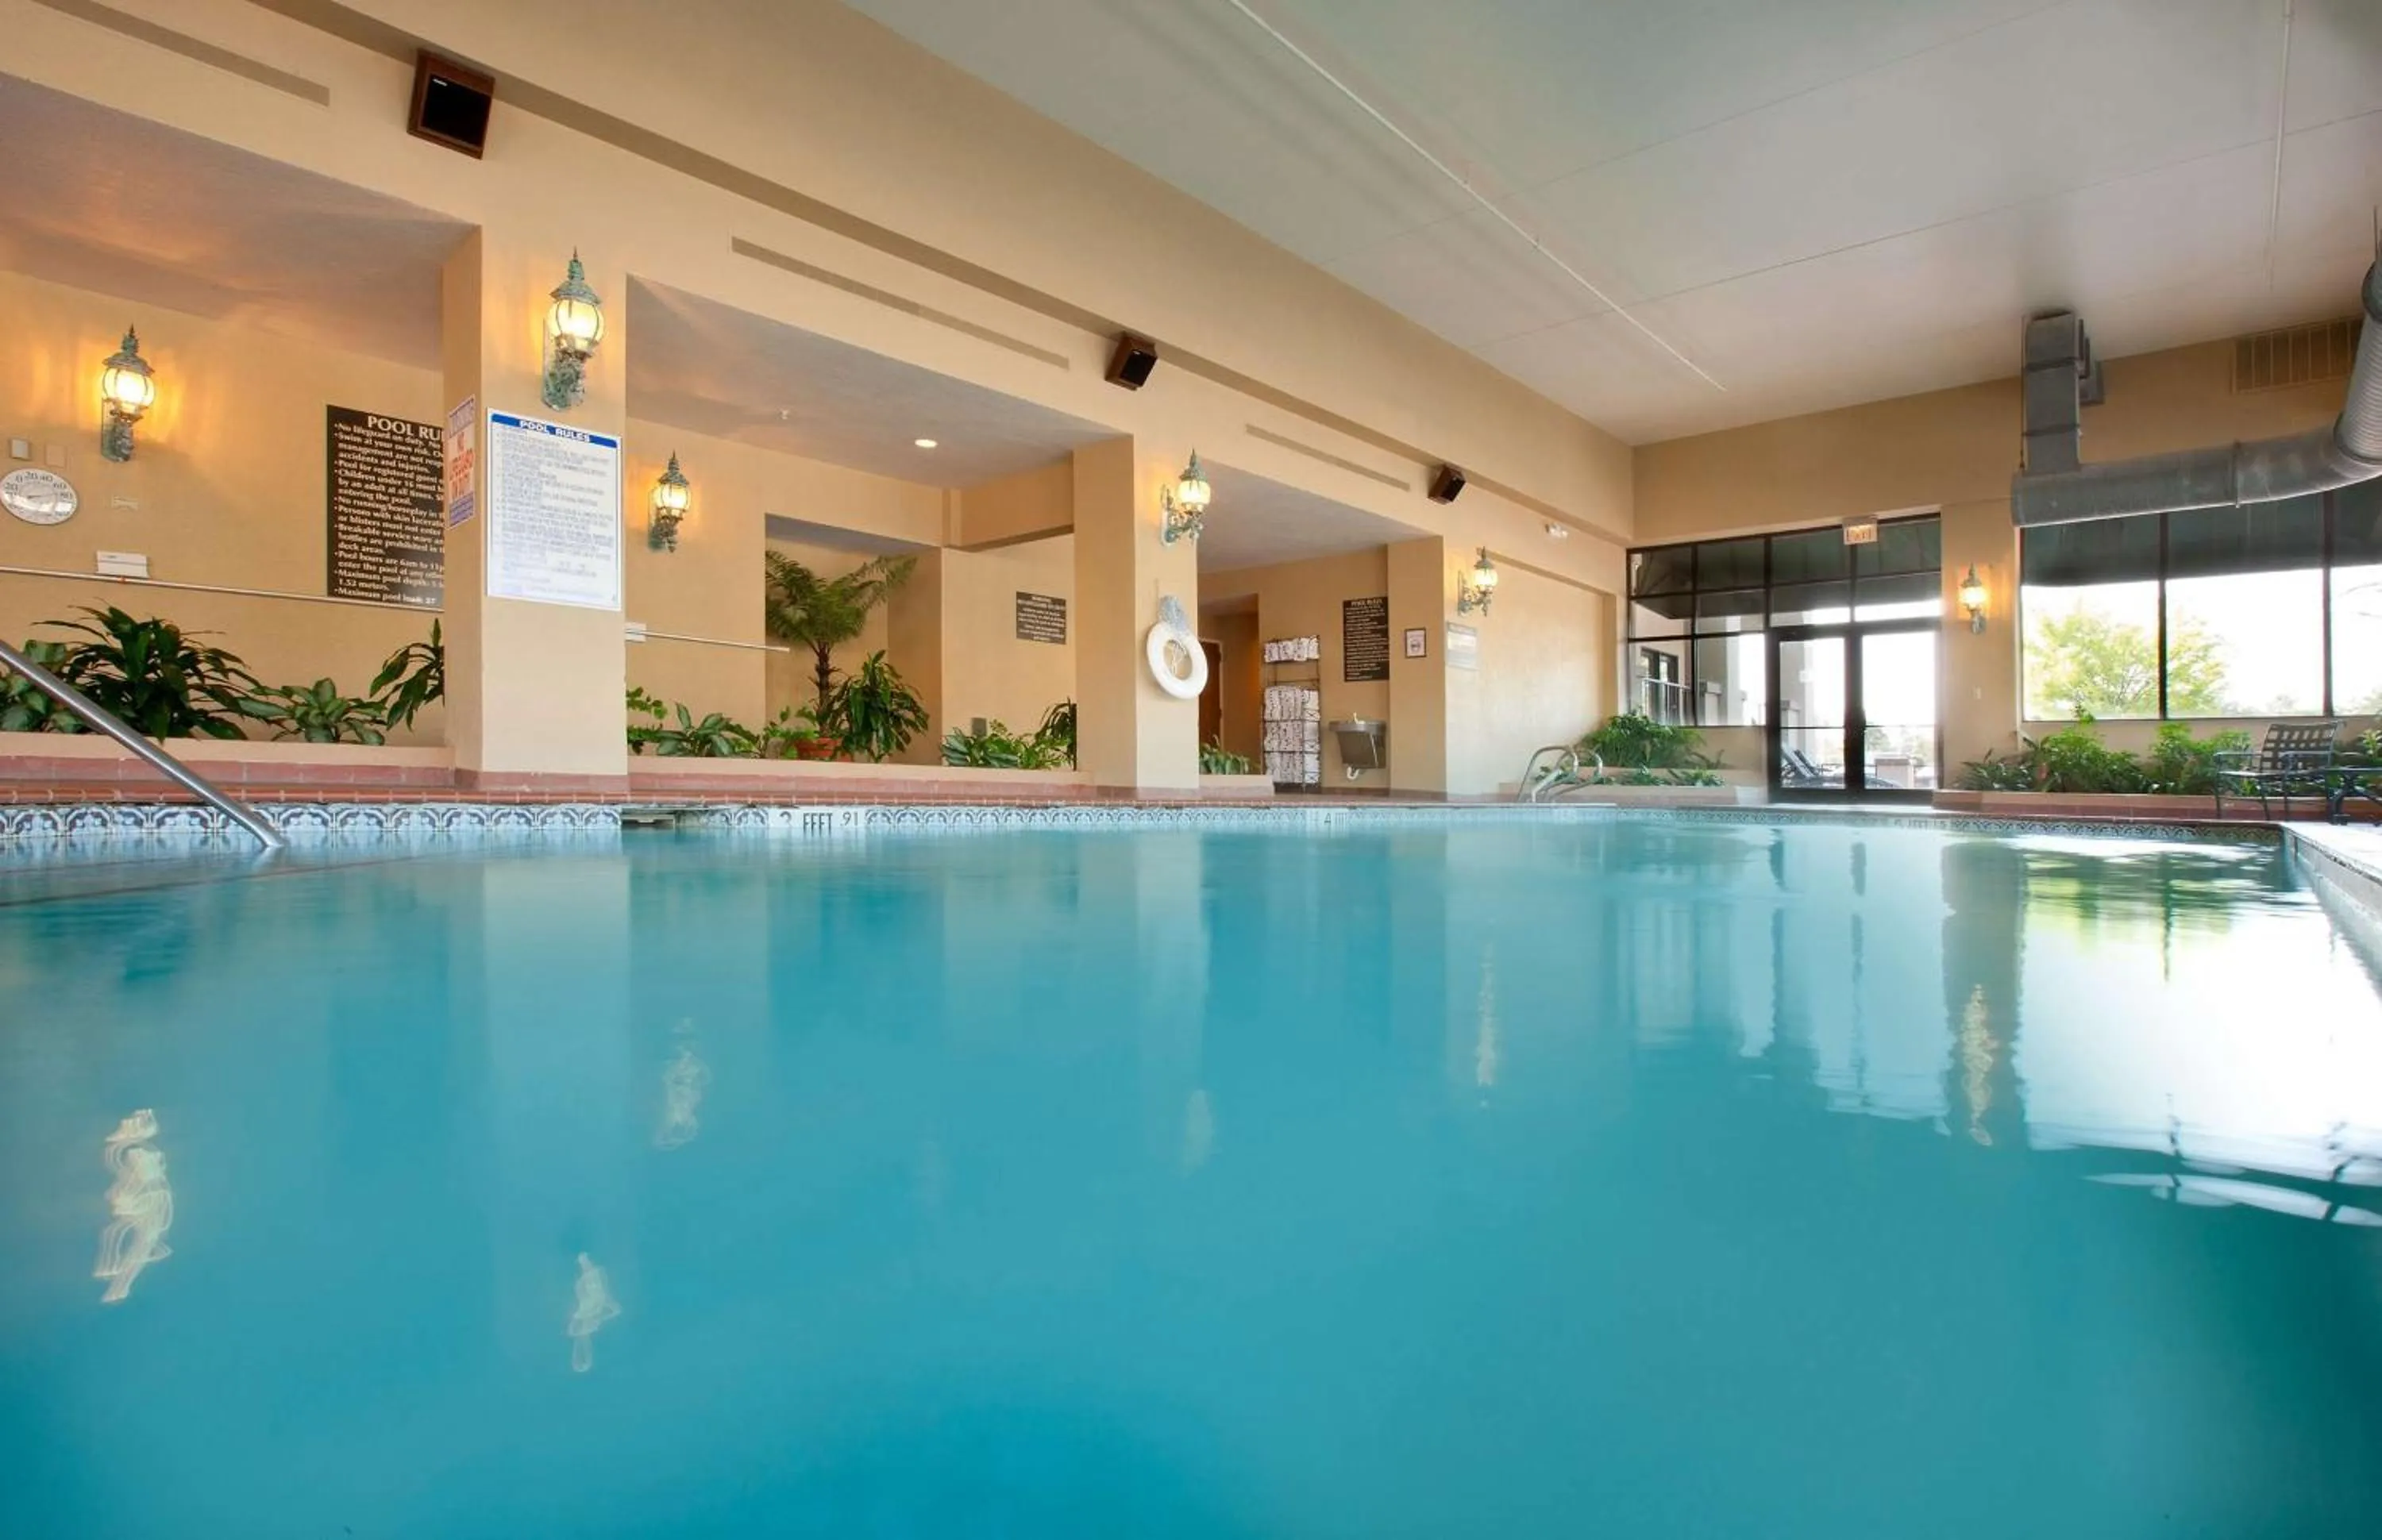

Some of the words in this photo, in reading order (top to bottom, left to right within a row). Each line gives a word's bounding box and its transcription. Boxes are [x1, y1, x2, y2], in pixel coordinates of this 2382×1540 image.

[353, 425, 390, 440] lifeguard
[368, 415, 414, 436] POOL
[419, 426, 441, 441] RU
[520, 420, 549, 435] POOL
[556, 428, 589, 442] RULES
[338, 432, 361, 442] Swim
[374, 440, 392, 450] your
[337, 441, 392, 459] management
[337, 449, 377, 463] accidents
[380, 457, 395, 467] and
[398, 460, 430, 474] injuries.
[338, 459, 357, 468] Pool
[359, 462, 372, 471] for
[373, 464, 414, 480] registered
[337, 468, 375, 480] Children
[377, 475, 401, 485] under
[415, 483, 435, 491] must
[364, 481, 385, 491] adult
[337, 487, 373, 499] entering
[338, 505, 370, 516] Persons
[372, 510, 391, 519] with
[349, 516, 380, 526] blisters
[382, 521, 402, 529] must
[337, 523, 380, 535] Breakable
[382, 529, 410, 540] service
[337, 532, 367, 543] bottles
[384, 539, 427, 553] prohibited
[337, 541, 358, 550] deck
[337, 550, 357, 559] Pool
[359, 552, 383, 562] hours
[337, 560, 360, 568] enter
[363, 562, 376, 571] the
[379, 564, 397, 575] pool
[338, 568, 380, 580] Maximum
[382, 574, 400, 585] pool
[337, 587, 380, 599] Maximum
[382, 592, 400, 603] pool
